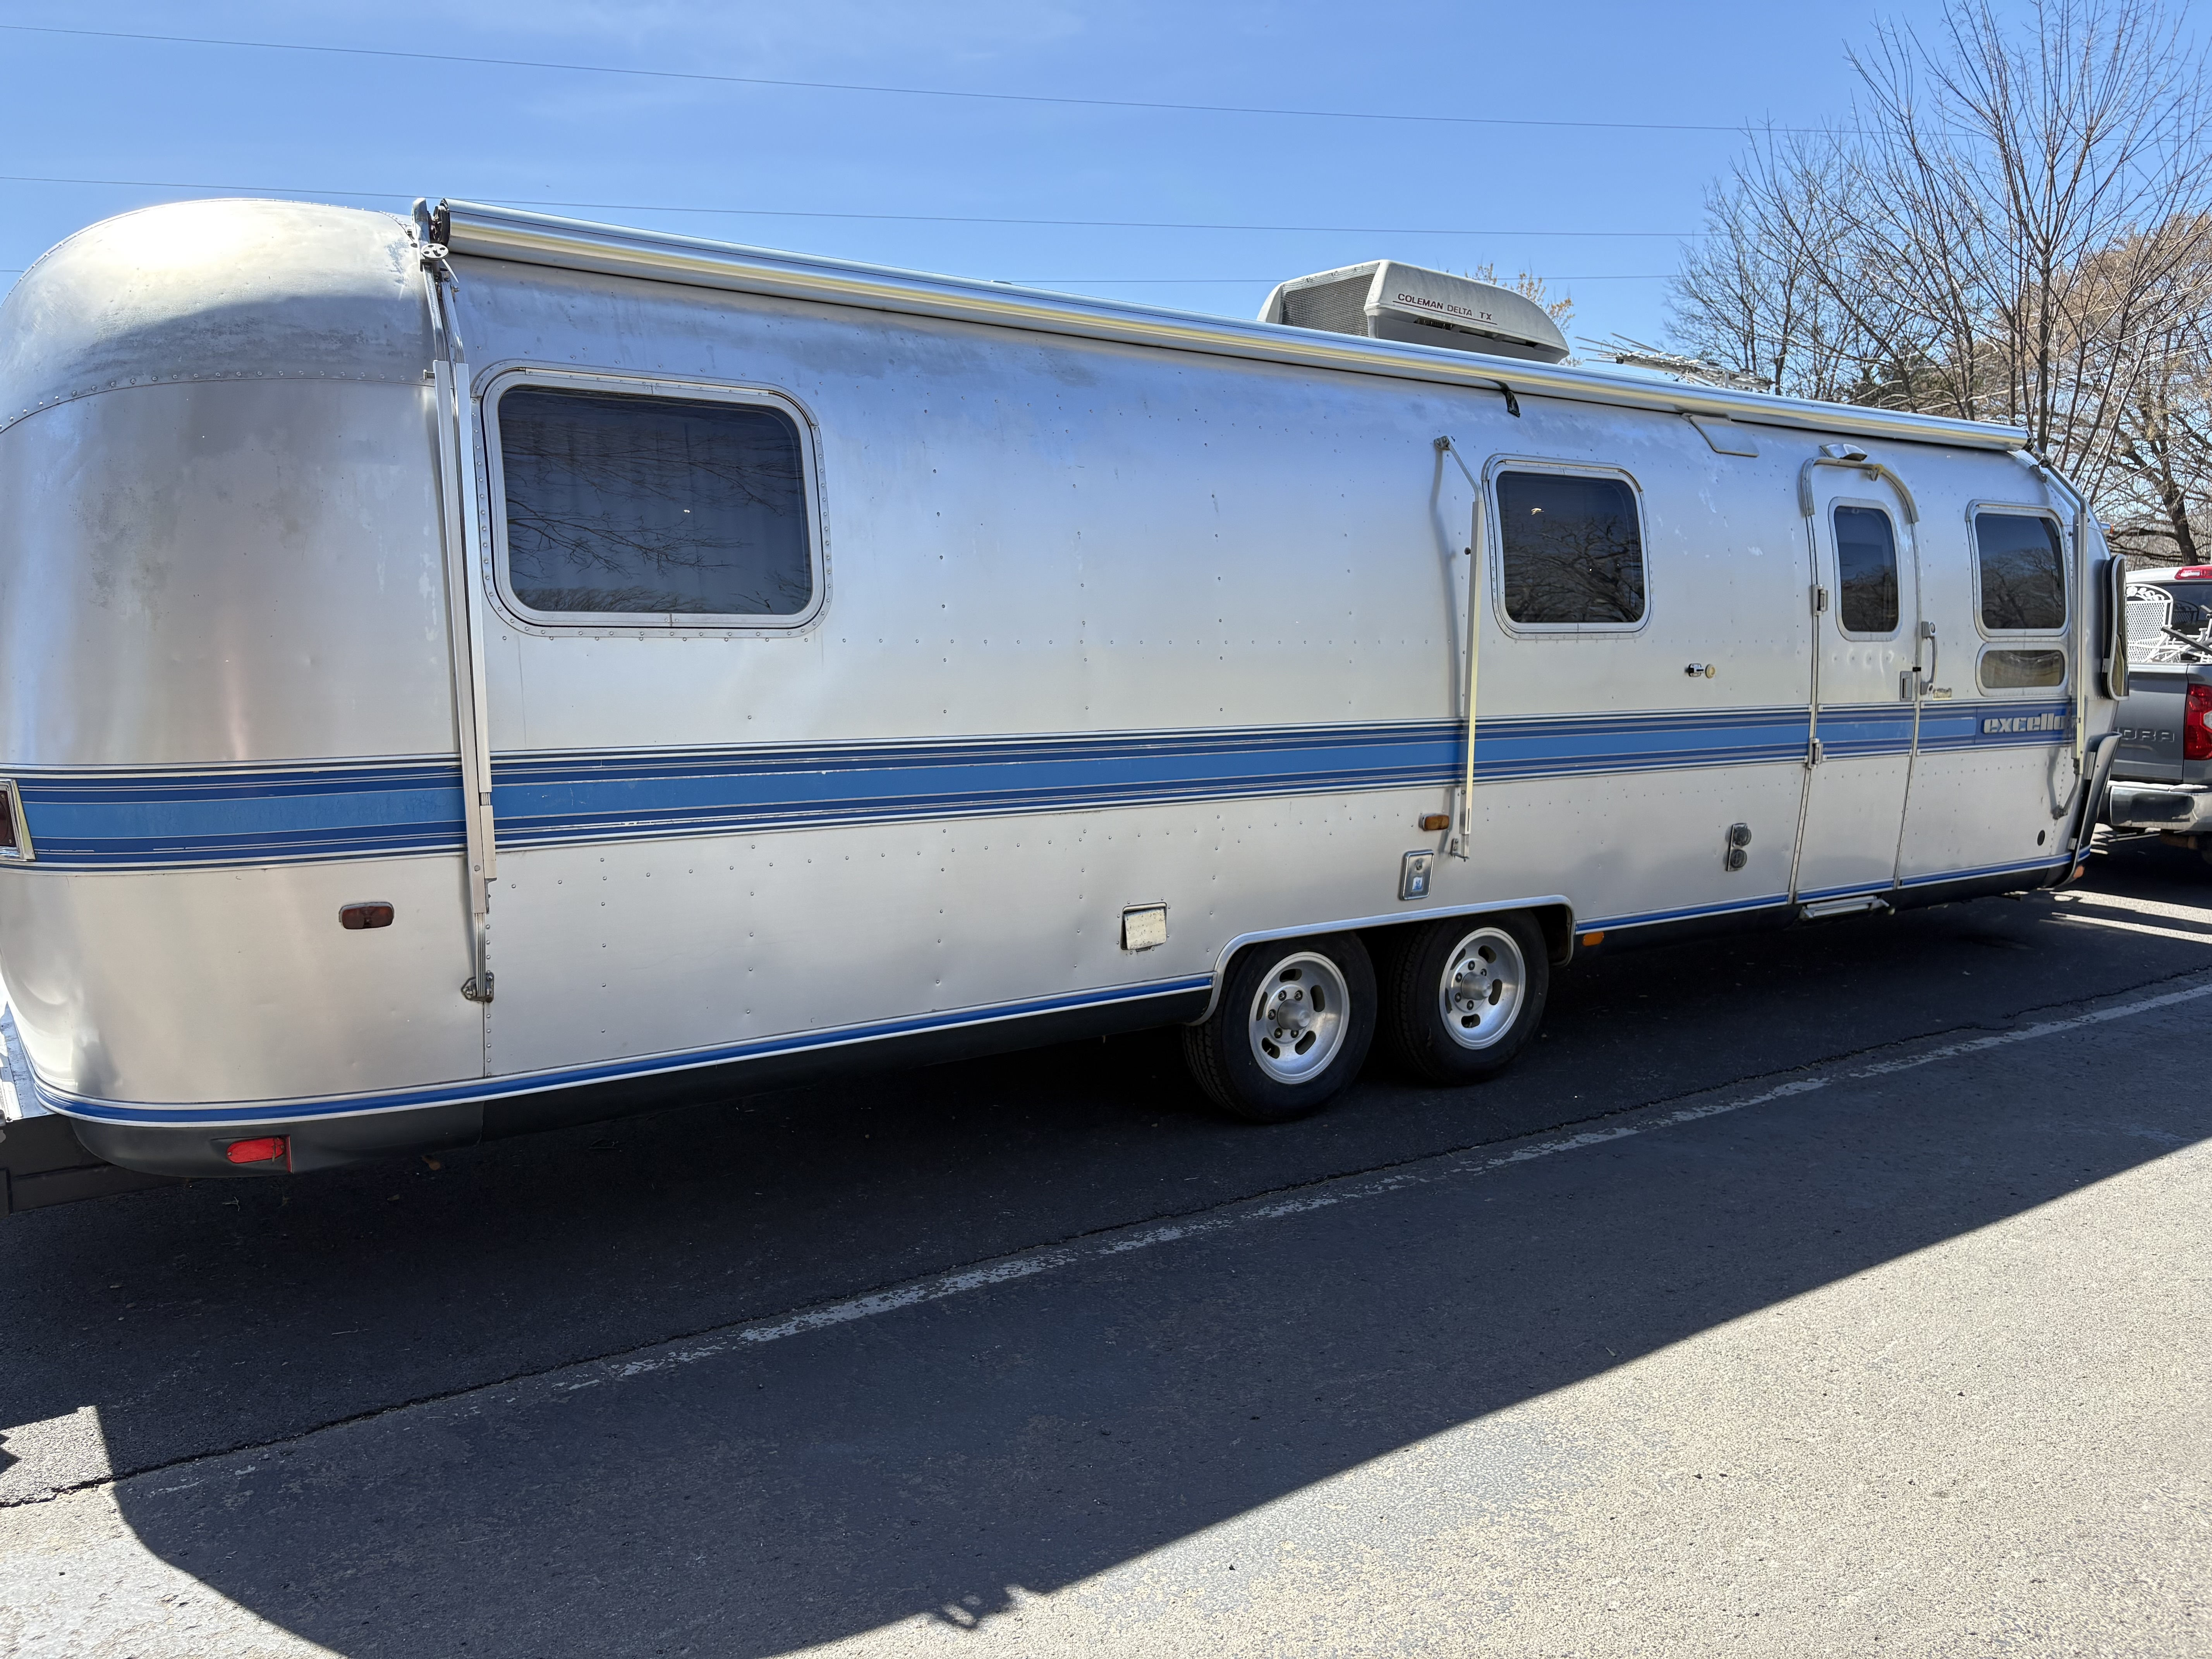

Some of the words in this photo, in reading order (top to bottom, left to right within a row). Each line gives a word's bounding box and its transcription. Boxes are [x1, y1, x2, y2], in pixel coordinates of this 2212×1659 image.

[1398, 293, 1443, 309] COLEMAN
[1447, 304, 1472, 316] DELTA
[1479, 312, 1492, 320] TX
[2115, 726, 2175, 742] DRA
